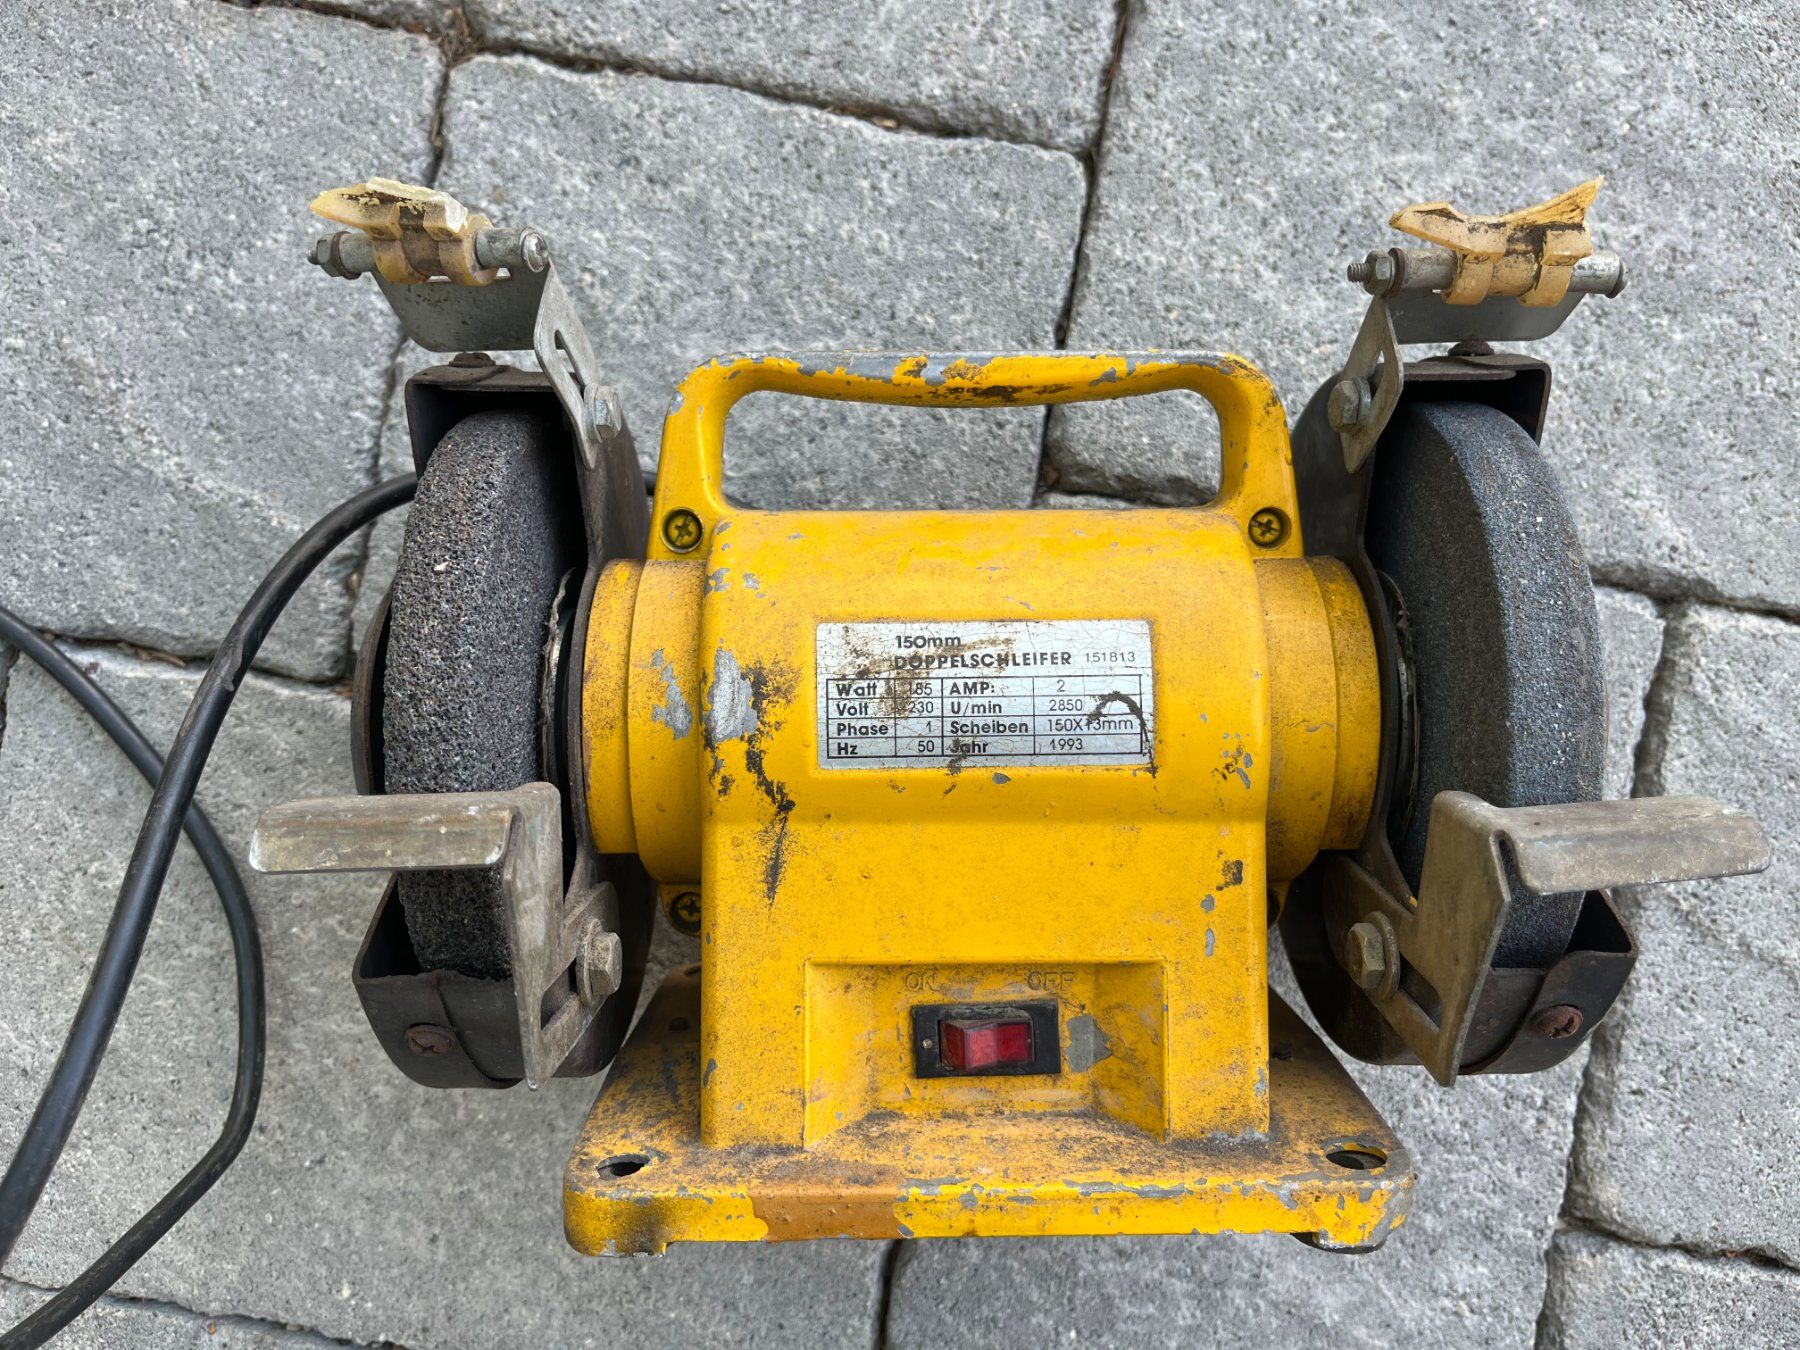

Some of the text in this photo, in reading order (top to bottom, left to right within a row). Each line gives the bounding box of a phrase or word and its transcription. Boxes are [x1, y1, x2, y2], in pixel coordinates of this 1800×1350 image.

[895, 635, 962, 649] 150mm
[894, 652, 1136, 669] DOPPELSCHLEIFER 151813
[836, 683, 878, 696] Watt
[949, 680, 1066, 695] AMP: 2
[836, 701, 934, 716] Volt 230
[951, 699, 1083, 715] U/min 2850
[837, 722, 932, 736] Phase 1
[950, 718, 1133, 734] Scheiben 150X13mm
[837, 740, 935, 755] Hz 50
[948, 739, 1084, 754] Jahr 1993
[905, 971, 936, 991] ON
[1027, 971, 1075, 990] OFF
